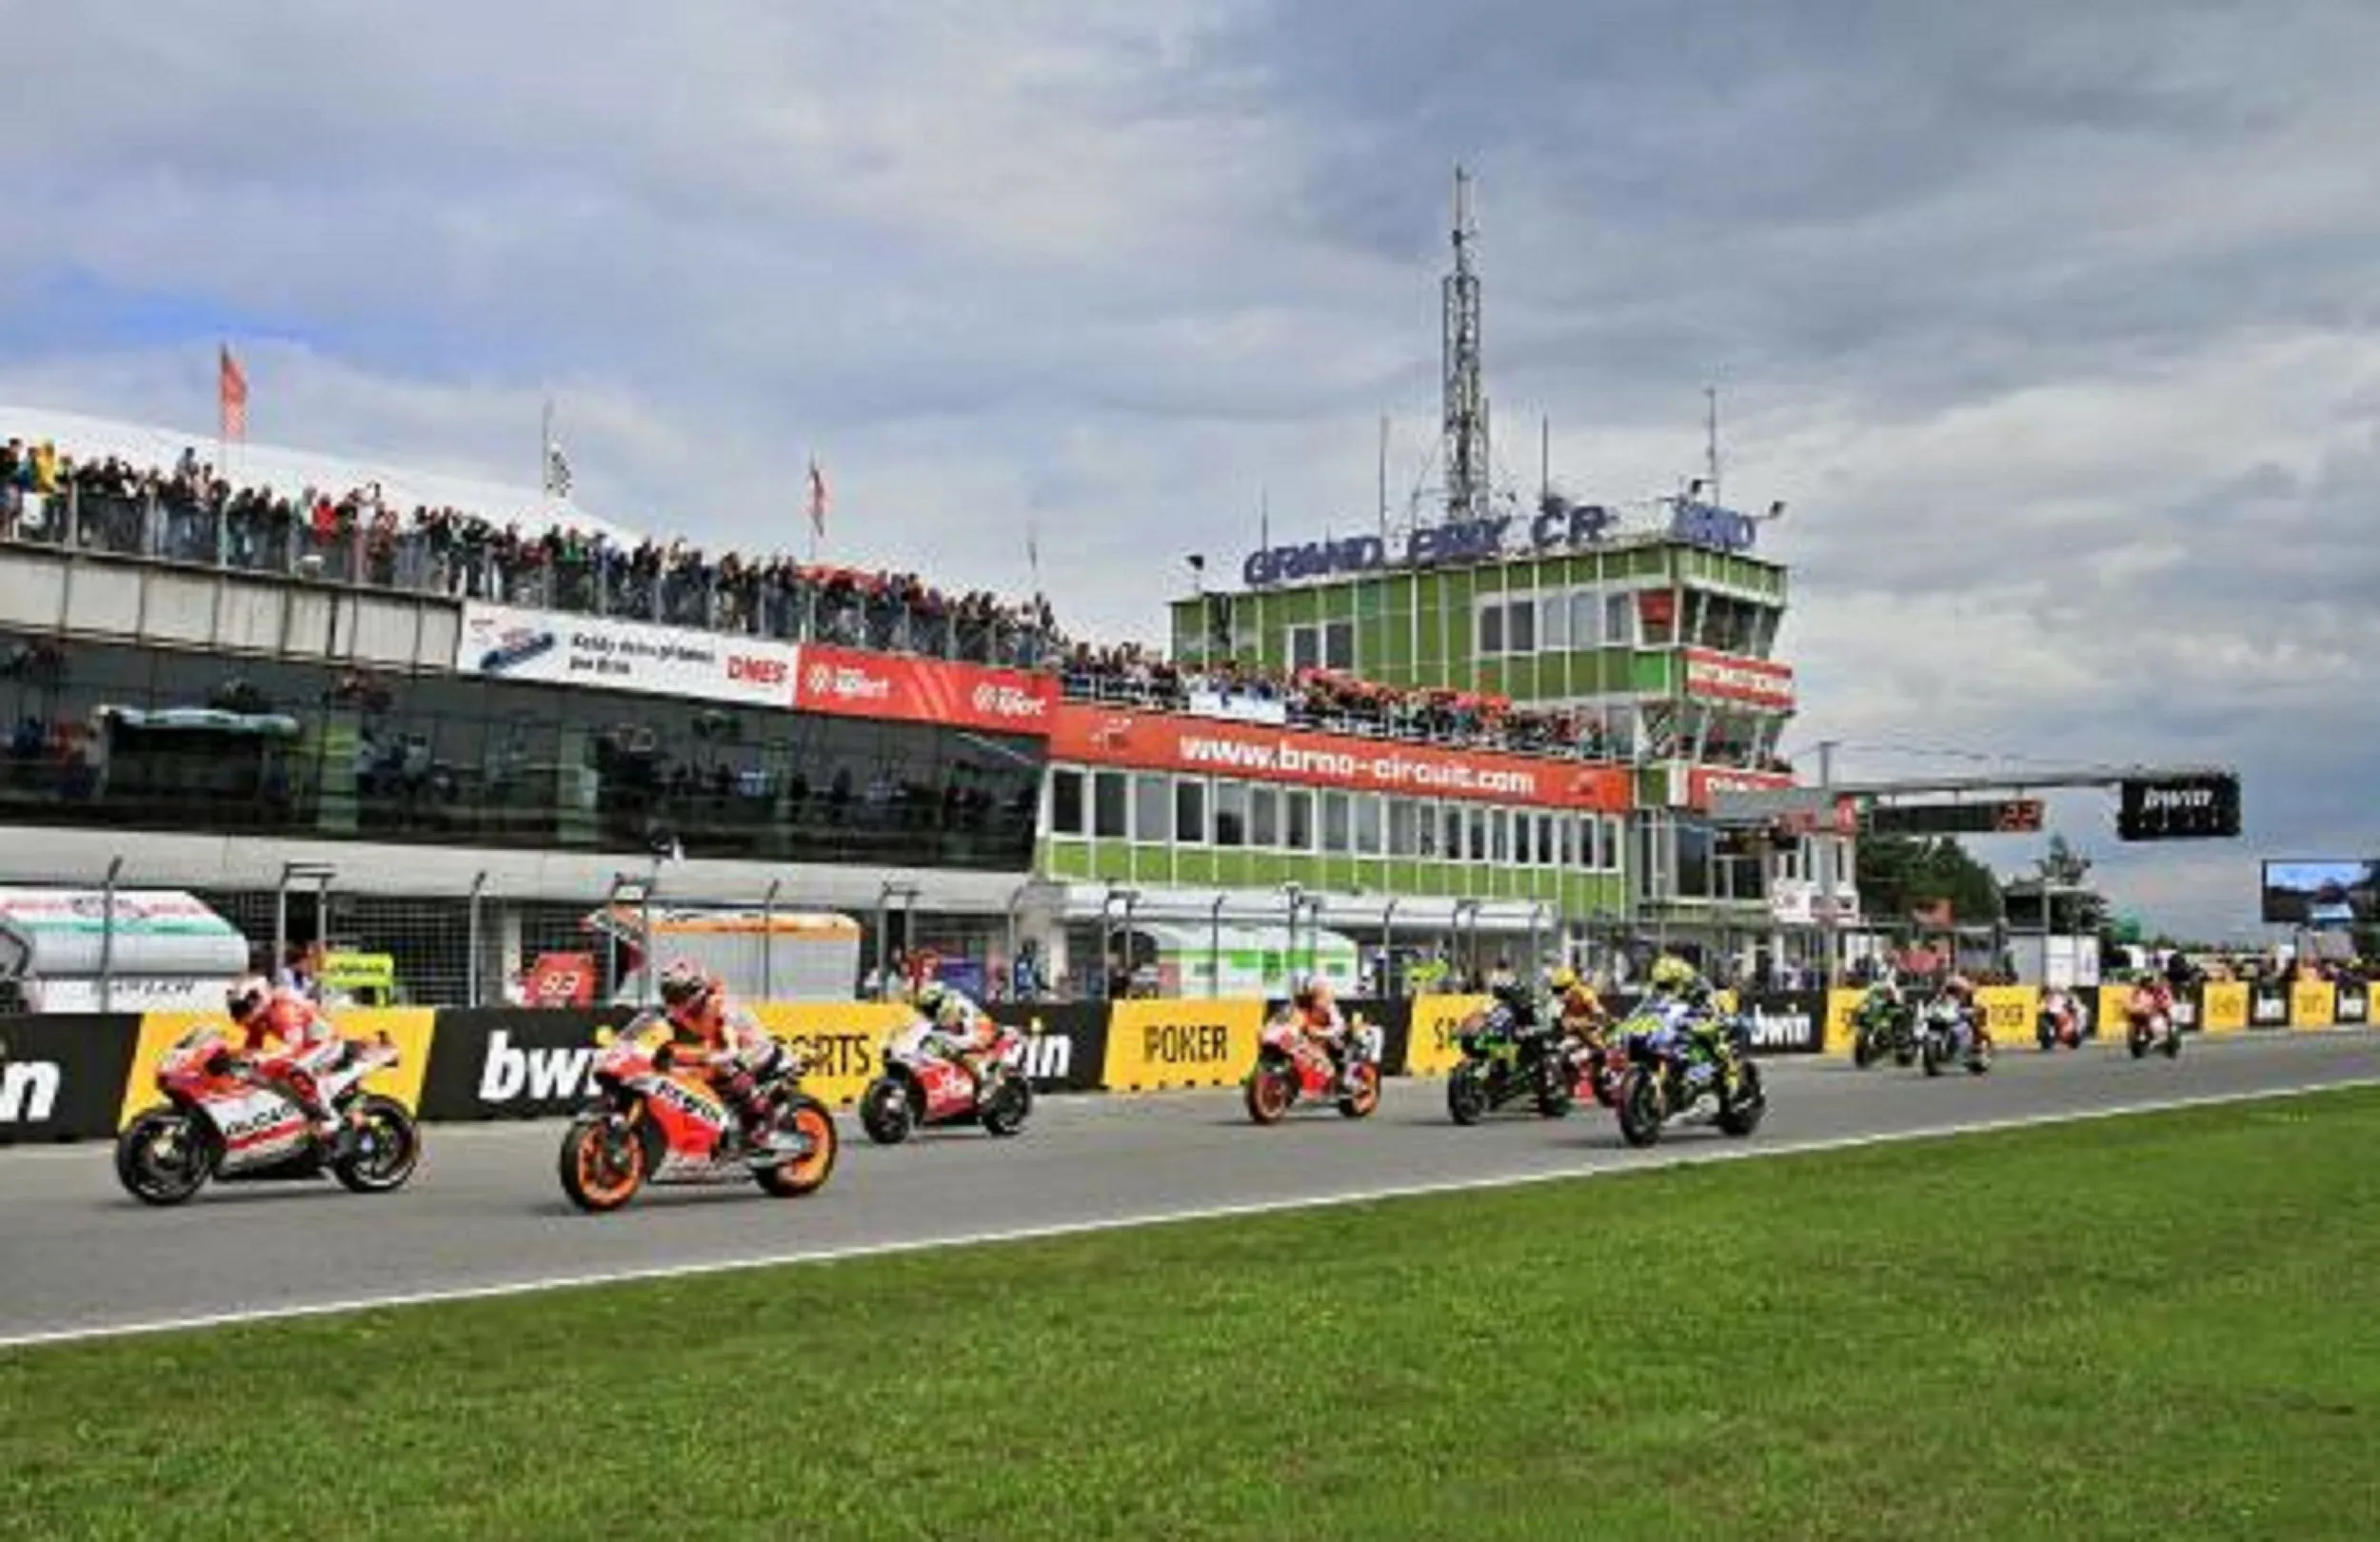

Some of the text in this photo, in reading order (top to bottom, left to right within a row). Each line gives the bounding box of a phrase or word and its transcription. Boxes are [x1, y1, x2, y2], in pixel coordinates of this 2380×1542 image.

[1243, 535, 1381, 583] GRAND
[1180, 737, 1535, 795] www.brno-circuit.com
[1144, 1025, 1228, 1063] POKER
[1751, 1003, 1812, 1045] bwin
